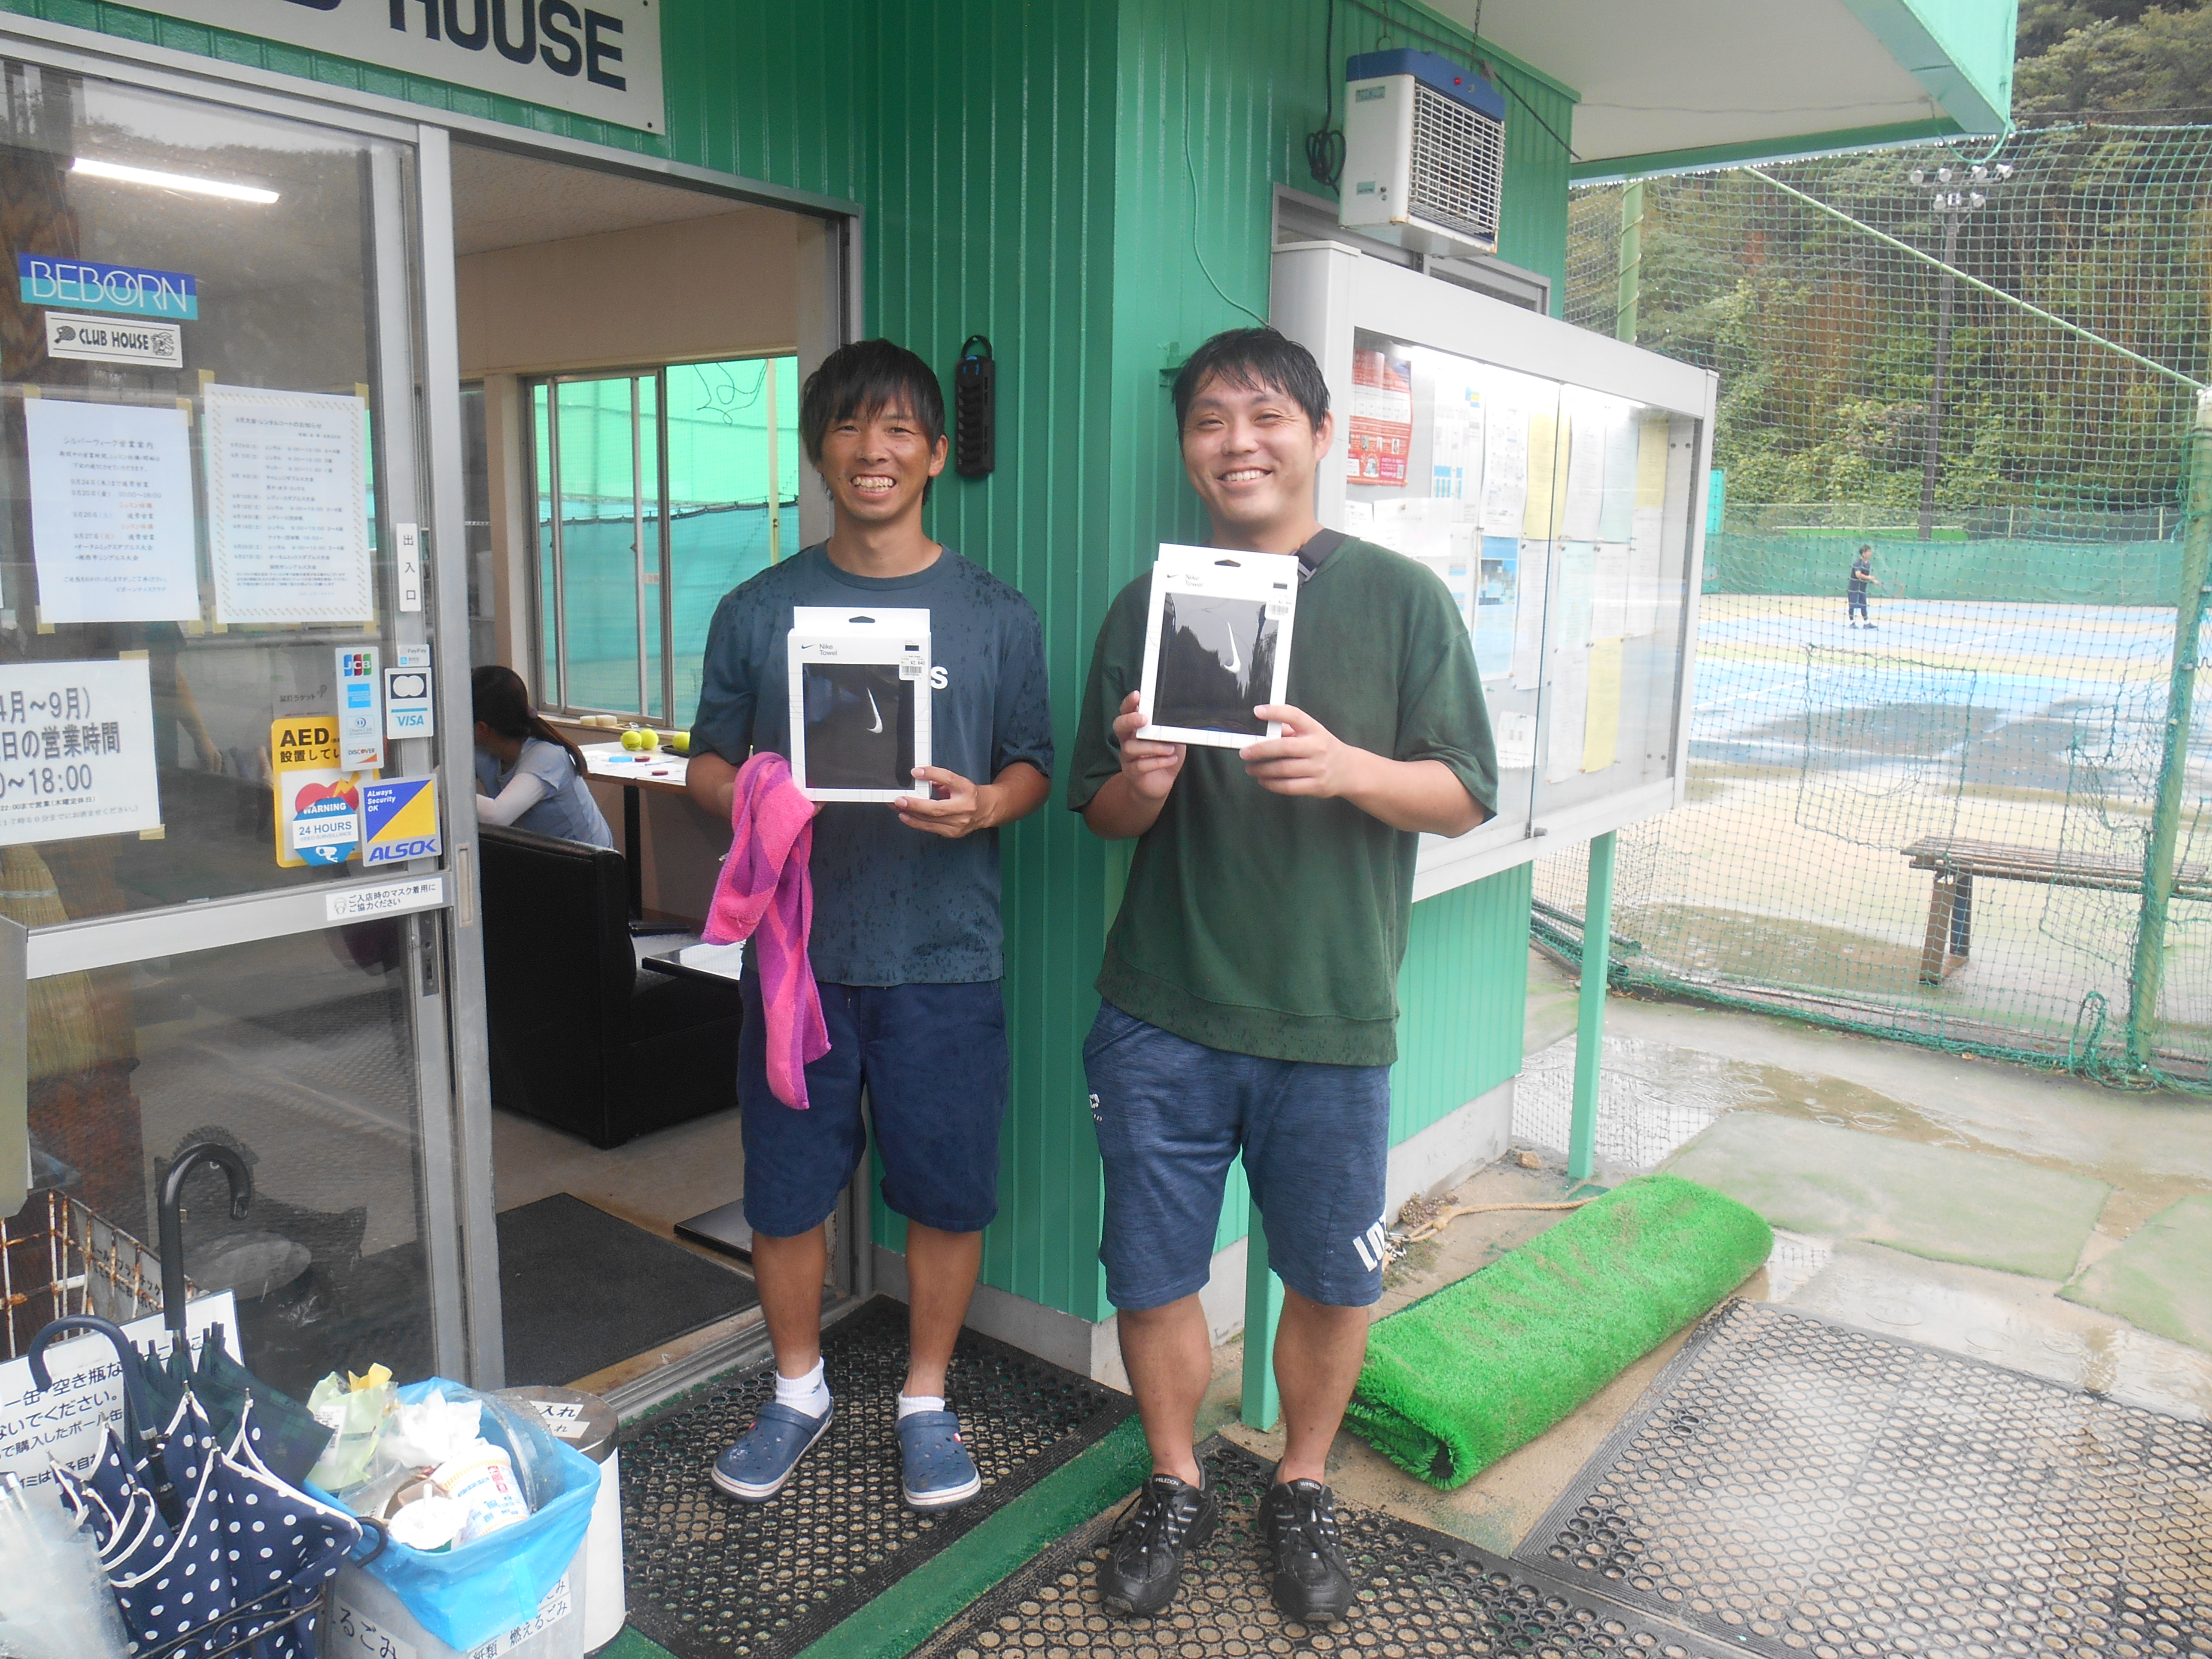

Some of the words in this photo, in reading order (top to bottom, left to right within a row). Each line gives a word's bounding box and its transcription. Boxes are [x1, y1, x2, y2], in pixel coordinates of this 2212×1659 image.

[30, 261, 187, 312] BEBORN
[79, 328, 107, 346] CLUB
[112, 331, 149, 350] HOUSE
[404, 534, 416, 600] 出入口
[930, 665, 948, 689] S
[397, 715, 424, 726] VISA
[0, 721, 121, 761] 日の営業時間
[280, 728, 330, 747] AED
[367, 789, 393, 798] ALways
[367, 796, 396, 805] Security
[0, 805, 139, 826] 17時50分までにお済ませください。)
[303, 802, 346, 814] WARNING
[368, 804, 379, 812] OK
[299, 826, 311, 836] 24
[314, 821, 352, 834] HOURS
[369, 839, 437, 862] ALSOK
[349, 884, 436, 903] ご入店時のマスク着用に
[349, 898, 401, 912] ご協力ください
[1352, 1213, 1386, 1273] LO
[509, 1600, 568, 1648] 燃えるごみ
